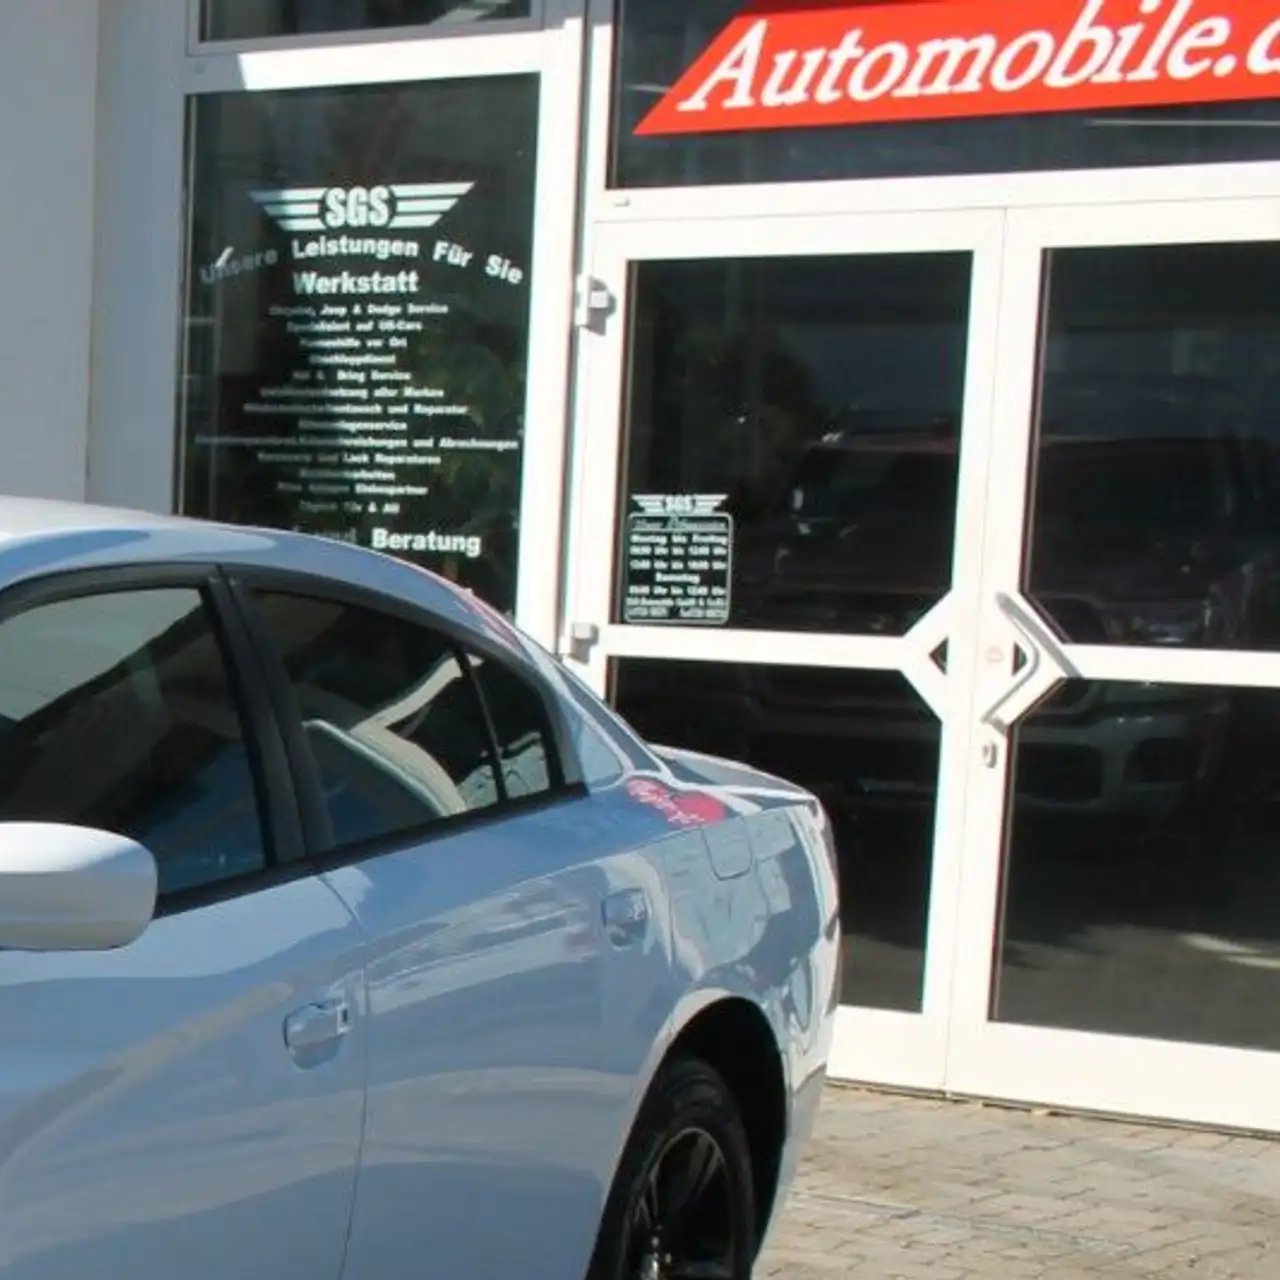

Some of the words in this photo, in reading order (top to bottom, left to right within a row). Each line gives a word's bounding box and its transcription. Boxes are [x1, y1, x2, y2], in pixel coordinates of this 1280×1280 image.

[324, 186, 390, 228] SGS
[292, 235, 420, 260] Leistungen
[431, 240, 473, 267] Für
[485, 254, 524, 285] Sie
[293, 271, 420, 295] Werkstatt
[371, 526, 481, 557] Beratung
